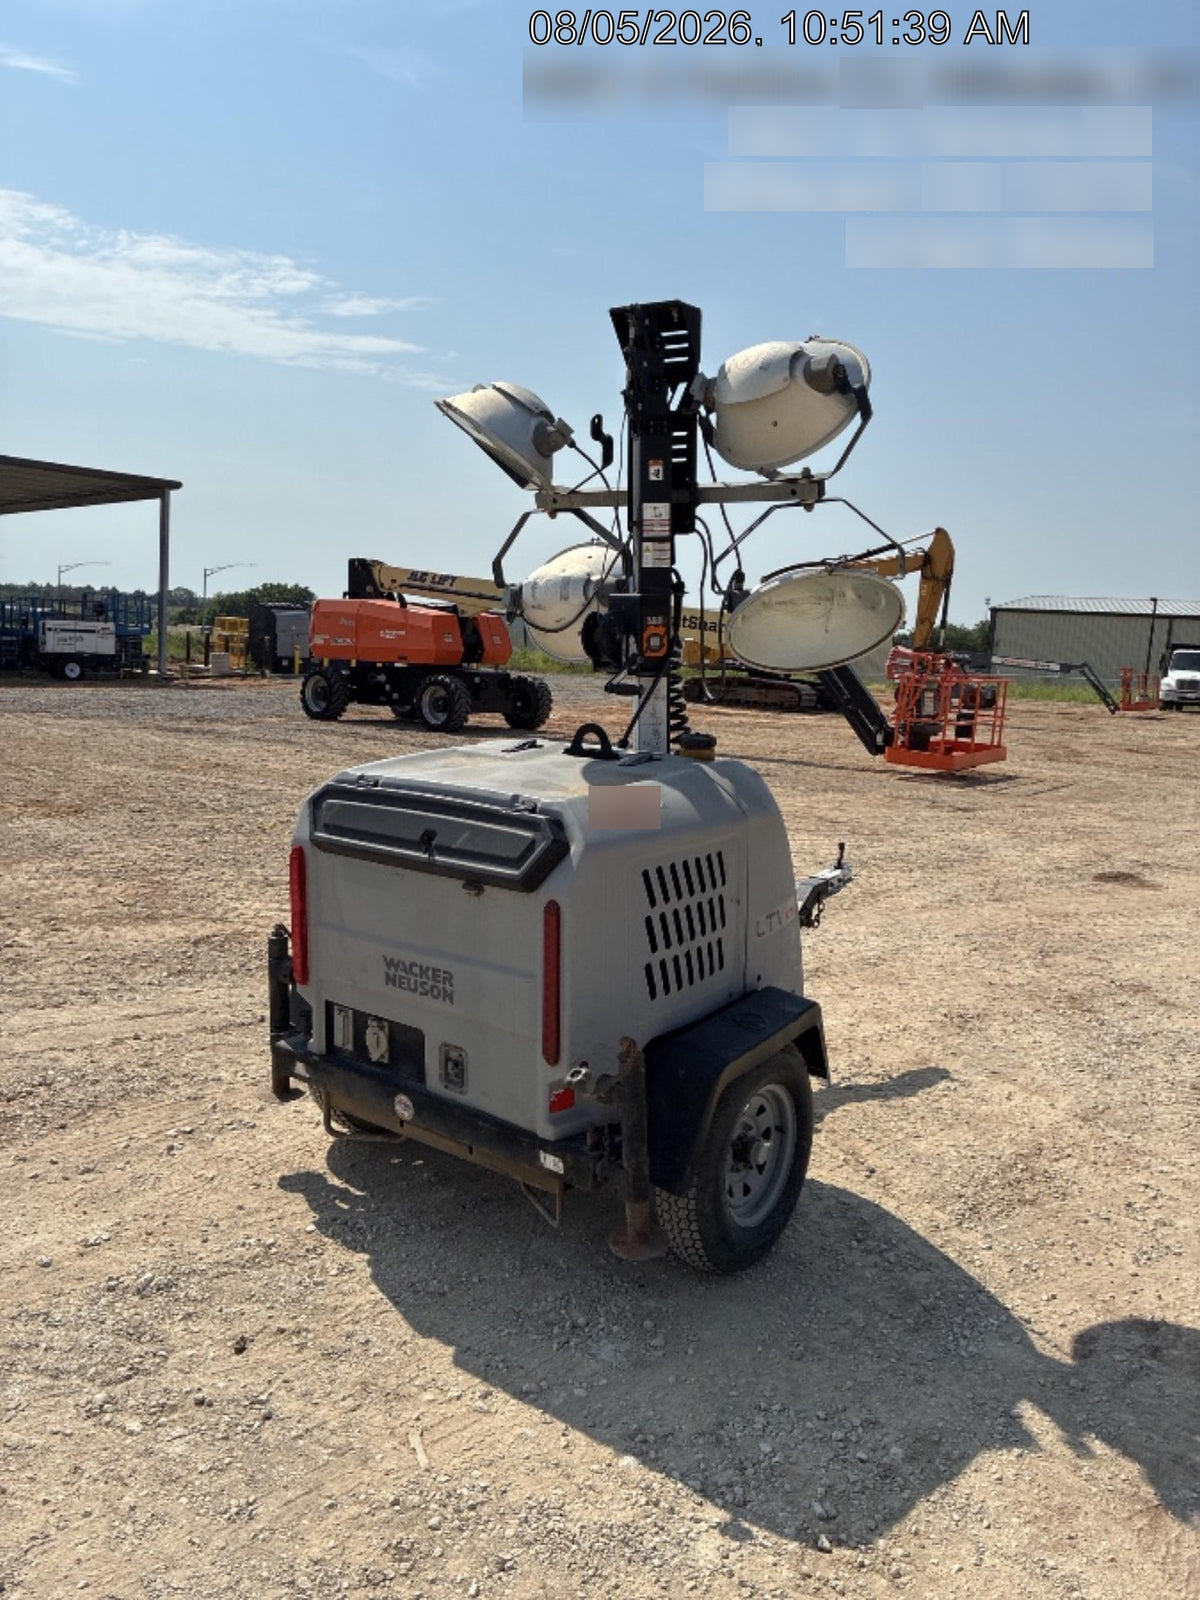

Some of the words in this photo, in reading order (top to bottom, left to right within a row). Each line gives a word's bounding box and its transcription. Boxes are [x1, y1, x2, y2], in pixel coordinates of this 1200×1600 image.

[407, 570, 429, 583] JLG
[430, 572, 457, 587] LIFT
[382, 954, 454, 988] WACKER
[384, 971, 454, 1005] NEUSON
